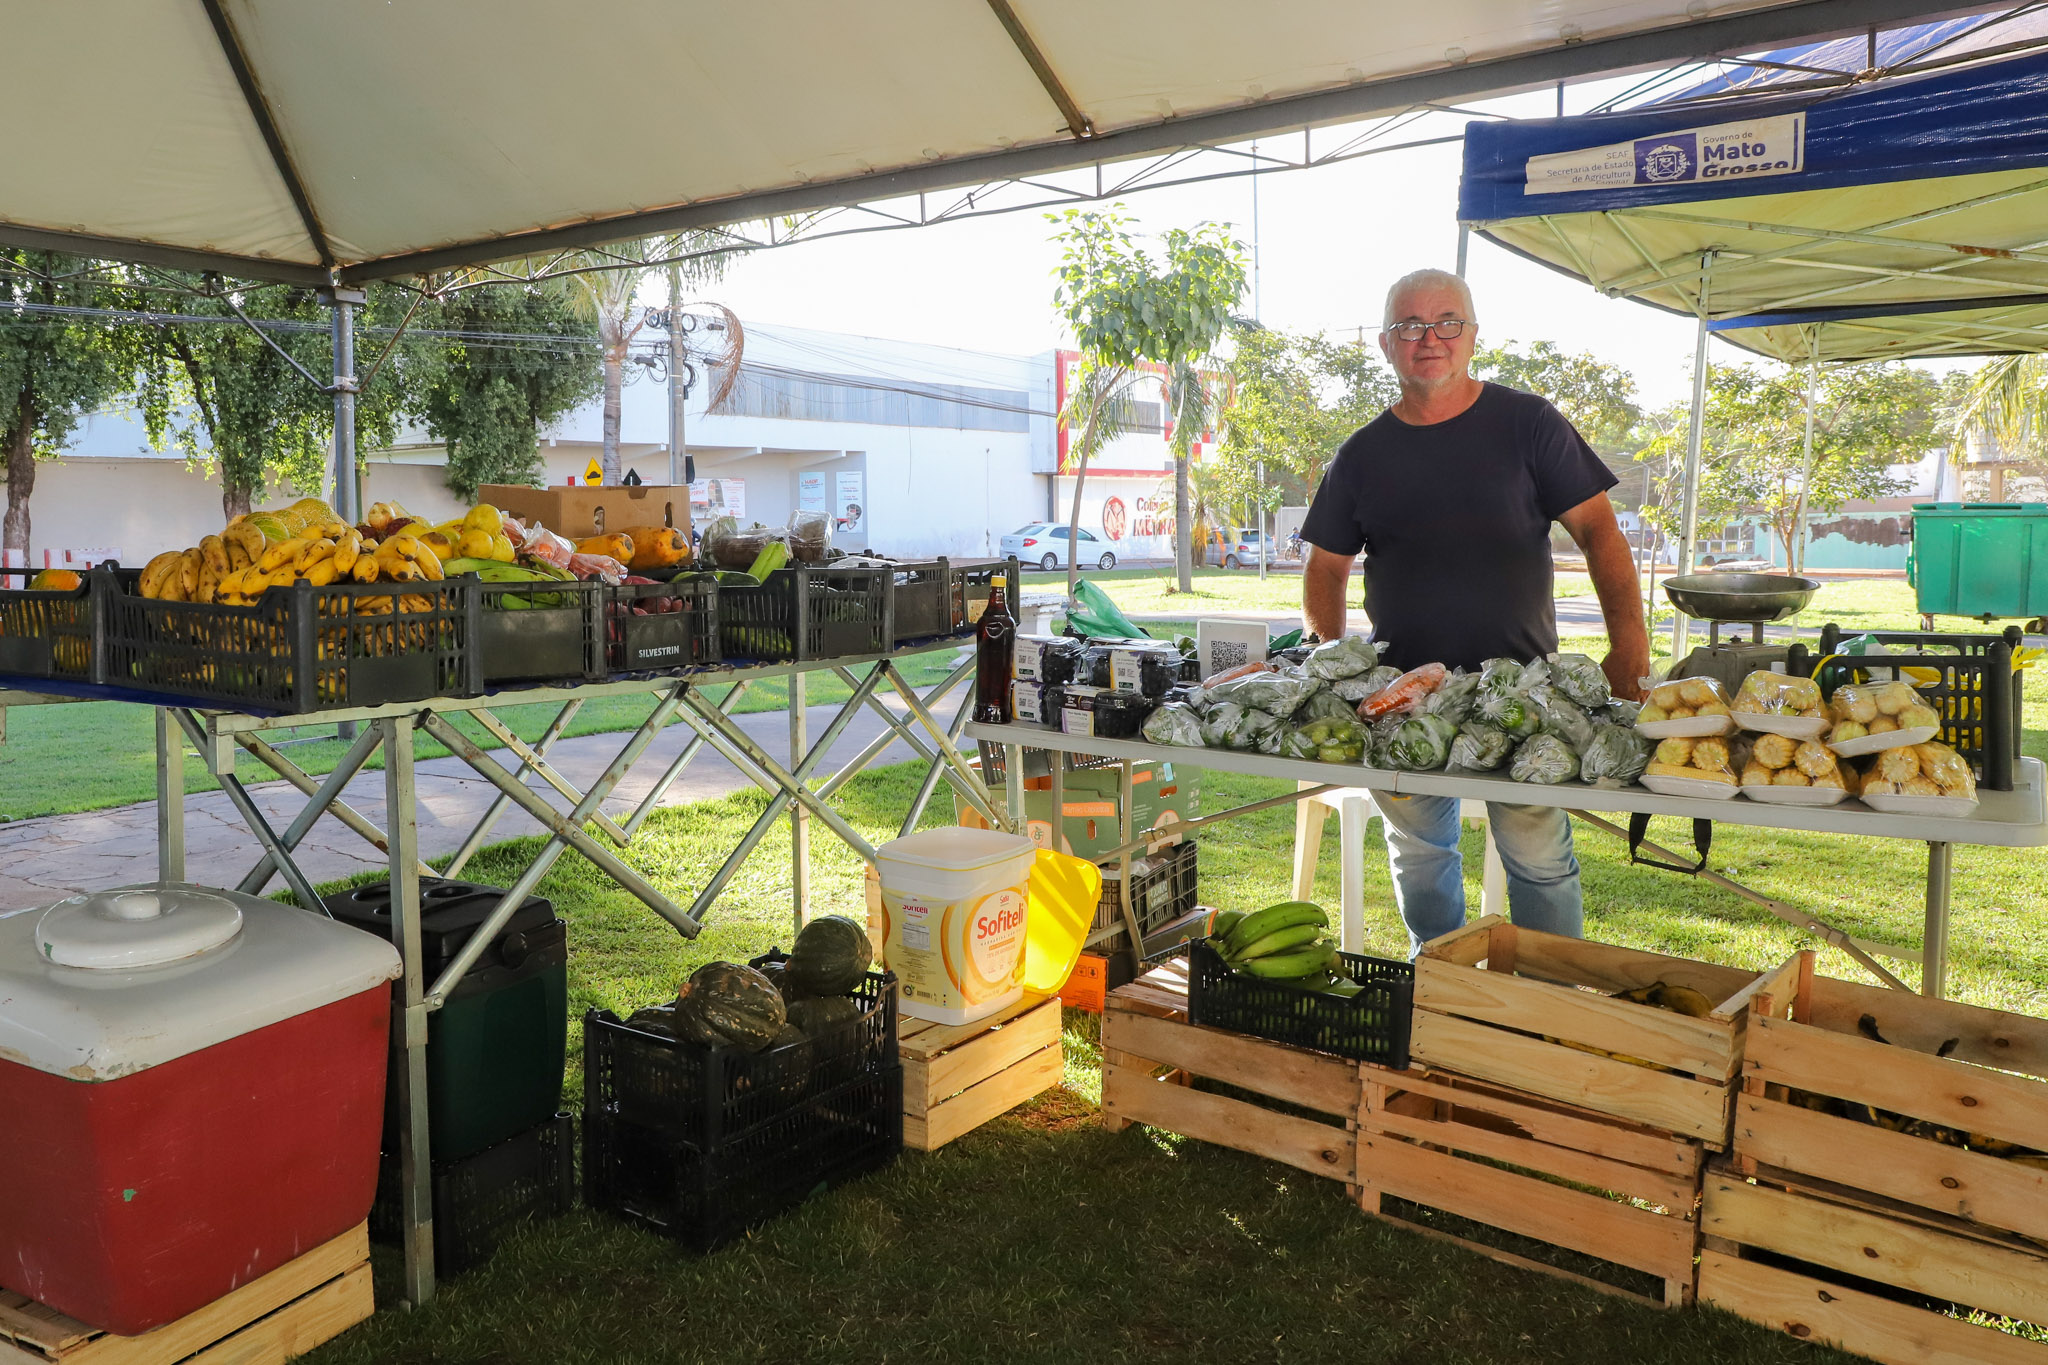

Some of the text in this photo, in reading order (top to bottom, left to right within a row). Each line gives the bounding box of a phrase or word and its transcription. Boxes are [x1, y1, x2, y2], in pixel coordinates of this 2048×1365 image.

[1703, 131, 1753, 144] Governo de
[1606, 150, 1629, 160] SEAF
[1703, 142, 1766, 163] Mato
[1547, 160, 1634, 177] Secretaria de Estado
[1702, 160, 1789, 178] Grosso
[1571, 170, 1631, 184] de Agricultura
[638, 645, 680, 658] SILVESTRIN
[977, 902, 1024, 940] Sofiteli
